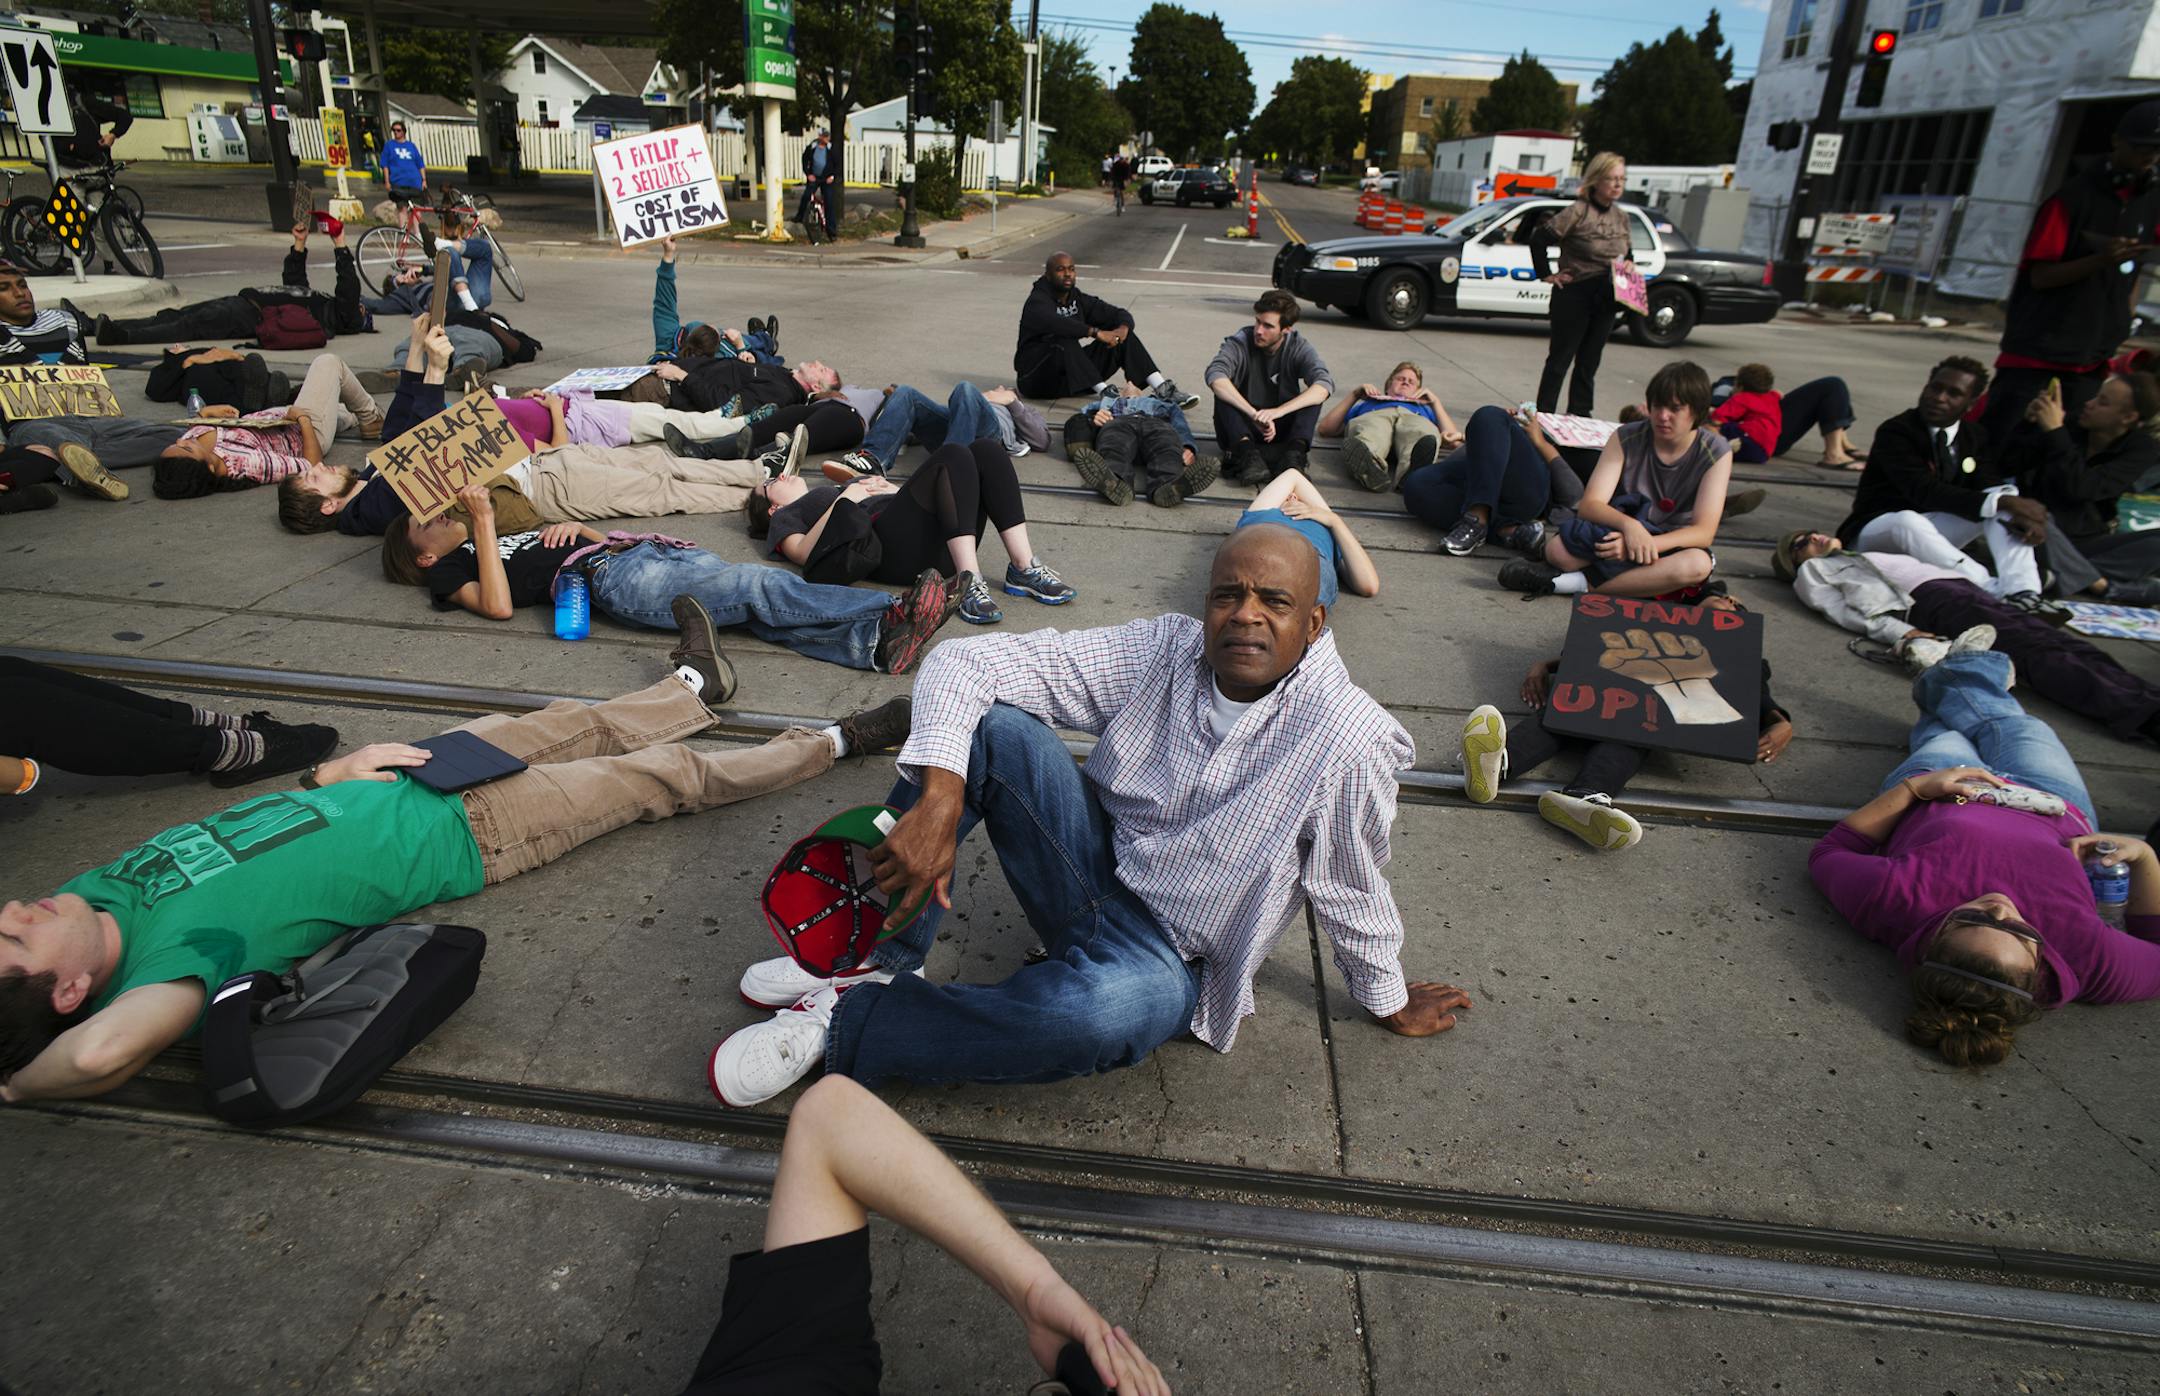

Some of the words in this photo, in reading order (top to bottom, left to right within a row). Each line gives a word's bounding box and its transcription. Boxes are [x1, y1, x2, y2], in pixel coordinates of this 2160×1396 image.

[764, 60, 785, 77] open
[225, 143, 246, 156] ICE
[612, 149, 624, 171] 1
[612, 176, 626, 198] 2
[631, 161, 691, 194] SEIZURES
[634, 193, 672, 218] COST
[680, 186, 700, 205] OF
[623, 201, 727, 242] AUTISM
[1357, 256, 1380, 268] 1885
[1483, 265, 1538, 282] PO
[1516, 290, 1551, 301] Metr
[0, 367, 63, 385] BLACK
[64, 367, 101, 383] LIVES
[0, 382, 124, 418] MATTER
[396, 446, 470, 517] LIVES
[1576, 593, 1745, 632] STAND
[1551, 682, 1660, 733] UP!
